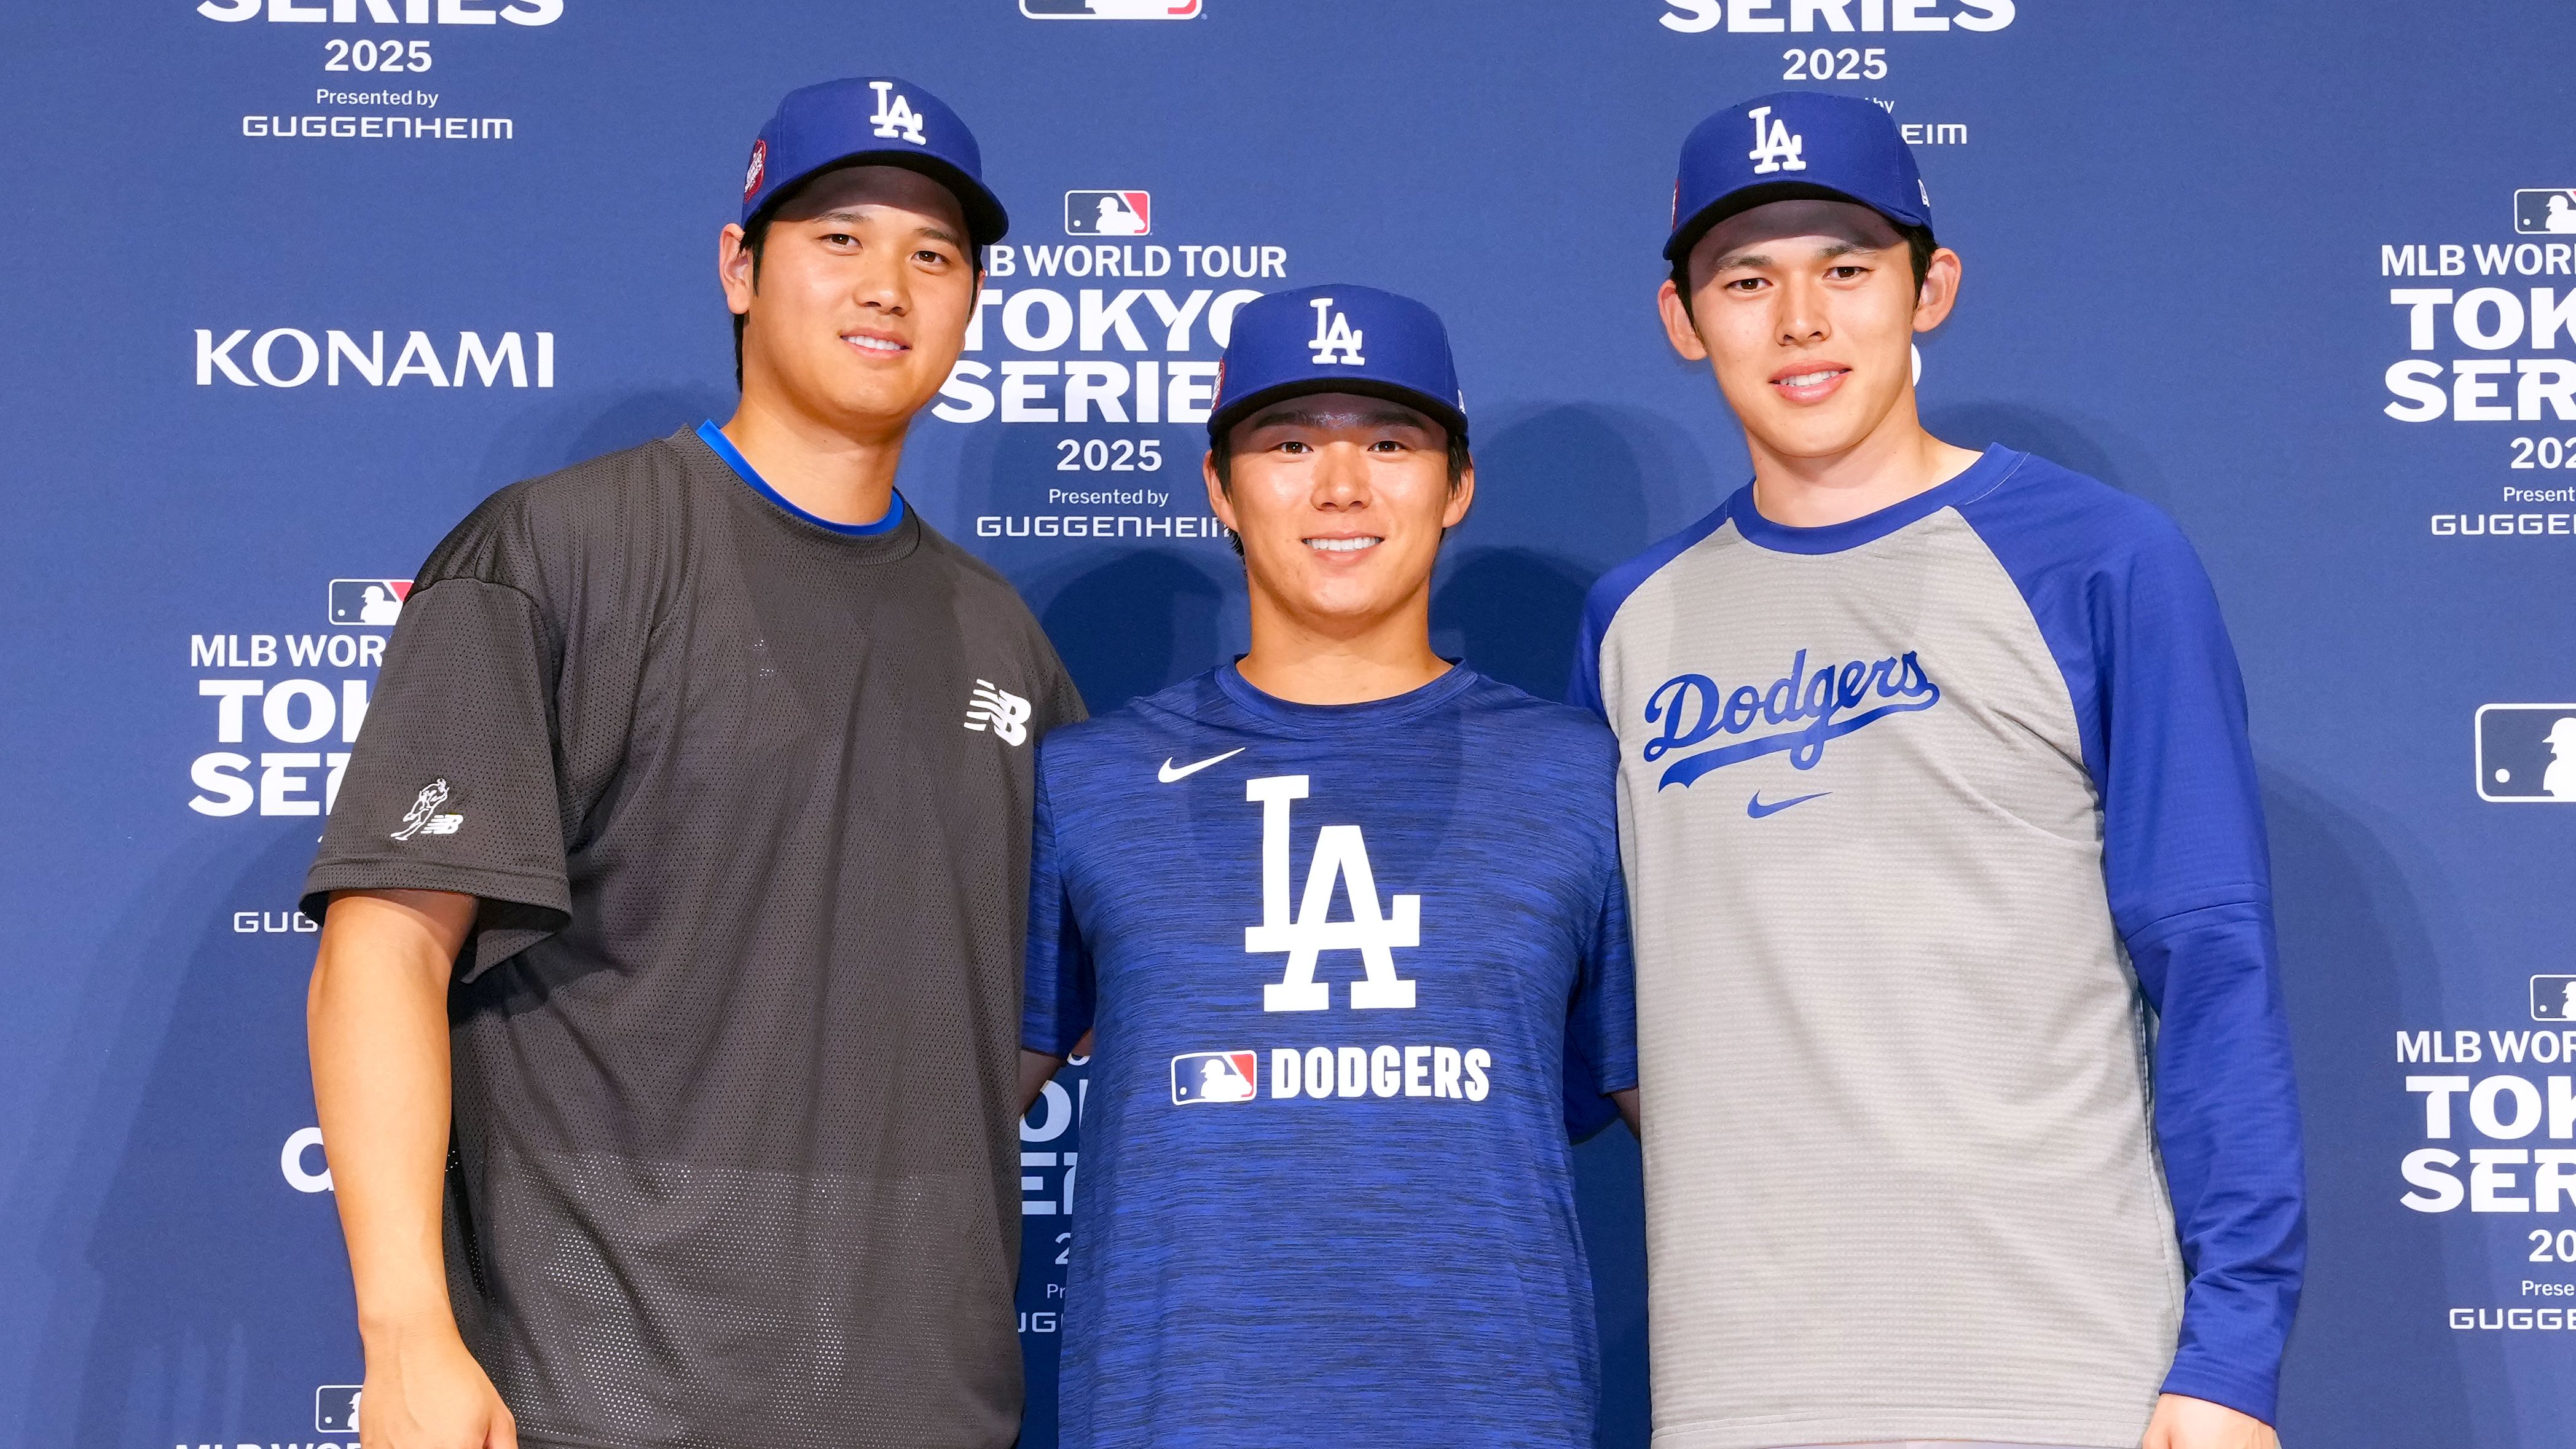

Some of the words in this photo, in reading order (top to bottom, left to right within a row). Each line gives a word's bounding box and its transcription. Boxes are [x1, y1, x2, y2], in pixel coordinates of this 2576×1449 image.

[324, 39, 432, 73] 2025
[1783, 48, 1888, 80] 2025
[316, 88, 412, 105] Presented
[417, 90, 439, 109] by
[869, 81, 927, 146] LA
[243, 116, 512, 139] GUGGENHEIM
[1748, 106, 1807, 175] LA
[1022, 245, 1171, 277] WORLD
[1178, 245, 1287, 278] TOUR
[2381, 244, 2466, 277] MLB
[2472, 243, 2576, 275] WOR
[1308, 297, 1365, 366] LA
[2390, 287, 2576, 351] TOK
[194, 328, 554, 388] KONAMI
[931, 359, 1219, 423] SERIE
[2383, 358, 2576, 423] SER
[1057, 439, 1162, 471] 2025
[1049, 489, 1142, 505] Presented
[1147, 489, 1169, 508] by
[2503, 486, 2575, 502] Present
[2431, 514, 2576, 535] GUGGE
[190, 634, 278, 667] MLB
[285, 634, 387, 667] WOR
[1643, 649, 1941, 793] Dodgers
[1244, 774, 1421, 1012] LA
[2396, 1031, 2482, 1063] MLB
[1271, 1045, 1491, 1102] DODGERS
[2400, 1148, 2576, 1213] SER
[2528, 1229, 2576, 1263] 20
[2521, 1280, 2575, 1297] Prese
